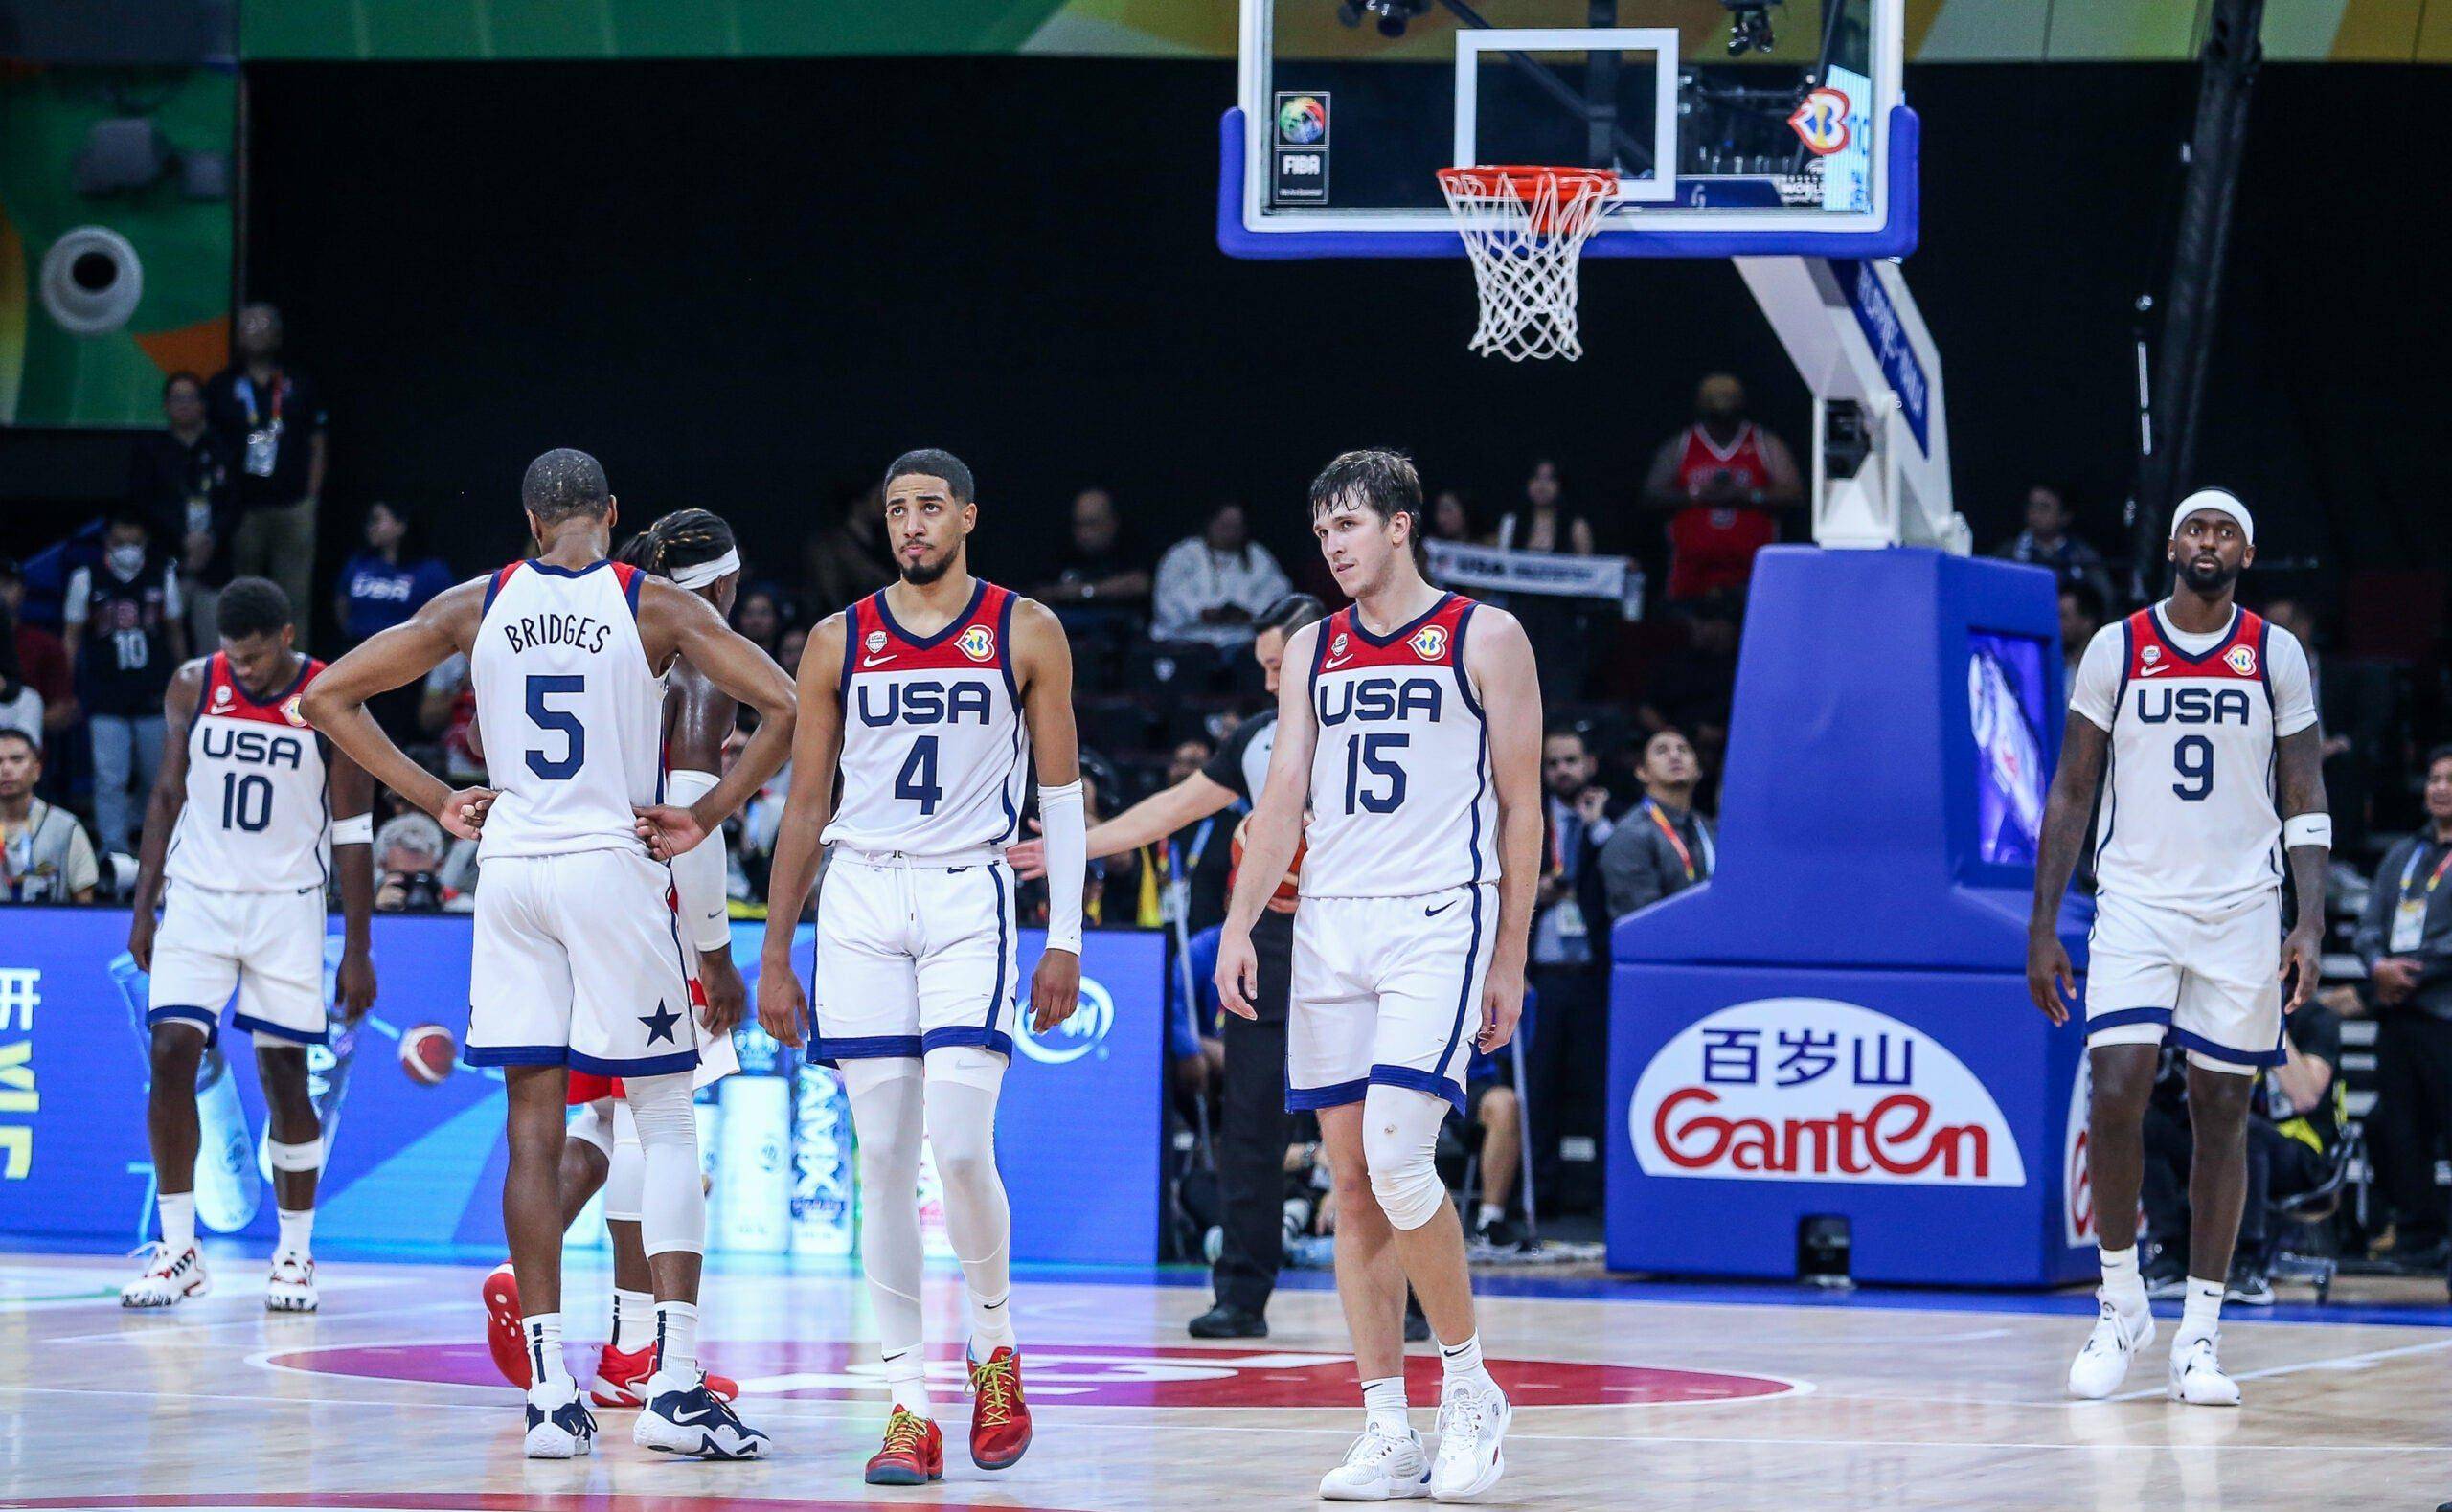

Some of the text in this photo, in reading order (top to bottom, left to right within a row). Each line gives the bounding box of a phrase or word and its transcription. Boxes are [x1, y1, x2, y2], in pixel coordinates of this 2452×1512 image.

[112, 629, 150, 671] 10
[504, 613, 611, 654] BRIDGES
[525, 674, 585, 780] 5
[857, 681, 992, 728] USA
[1319, 677, 1442, 728] USA
[2137, 688, 2250, 726] USA
[202, 727, 302, 770] USA
[894, 734, 943, 816] 4
[1345, 733, 1410, 816] 15
[2172, 734, 2214, 801] 9
[222, 772, 274, 833] 10
[1701, 1027, 1914, 1089] 百岁山
